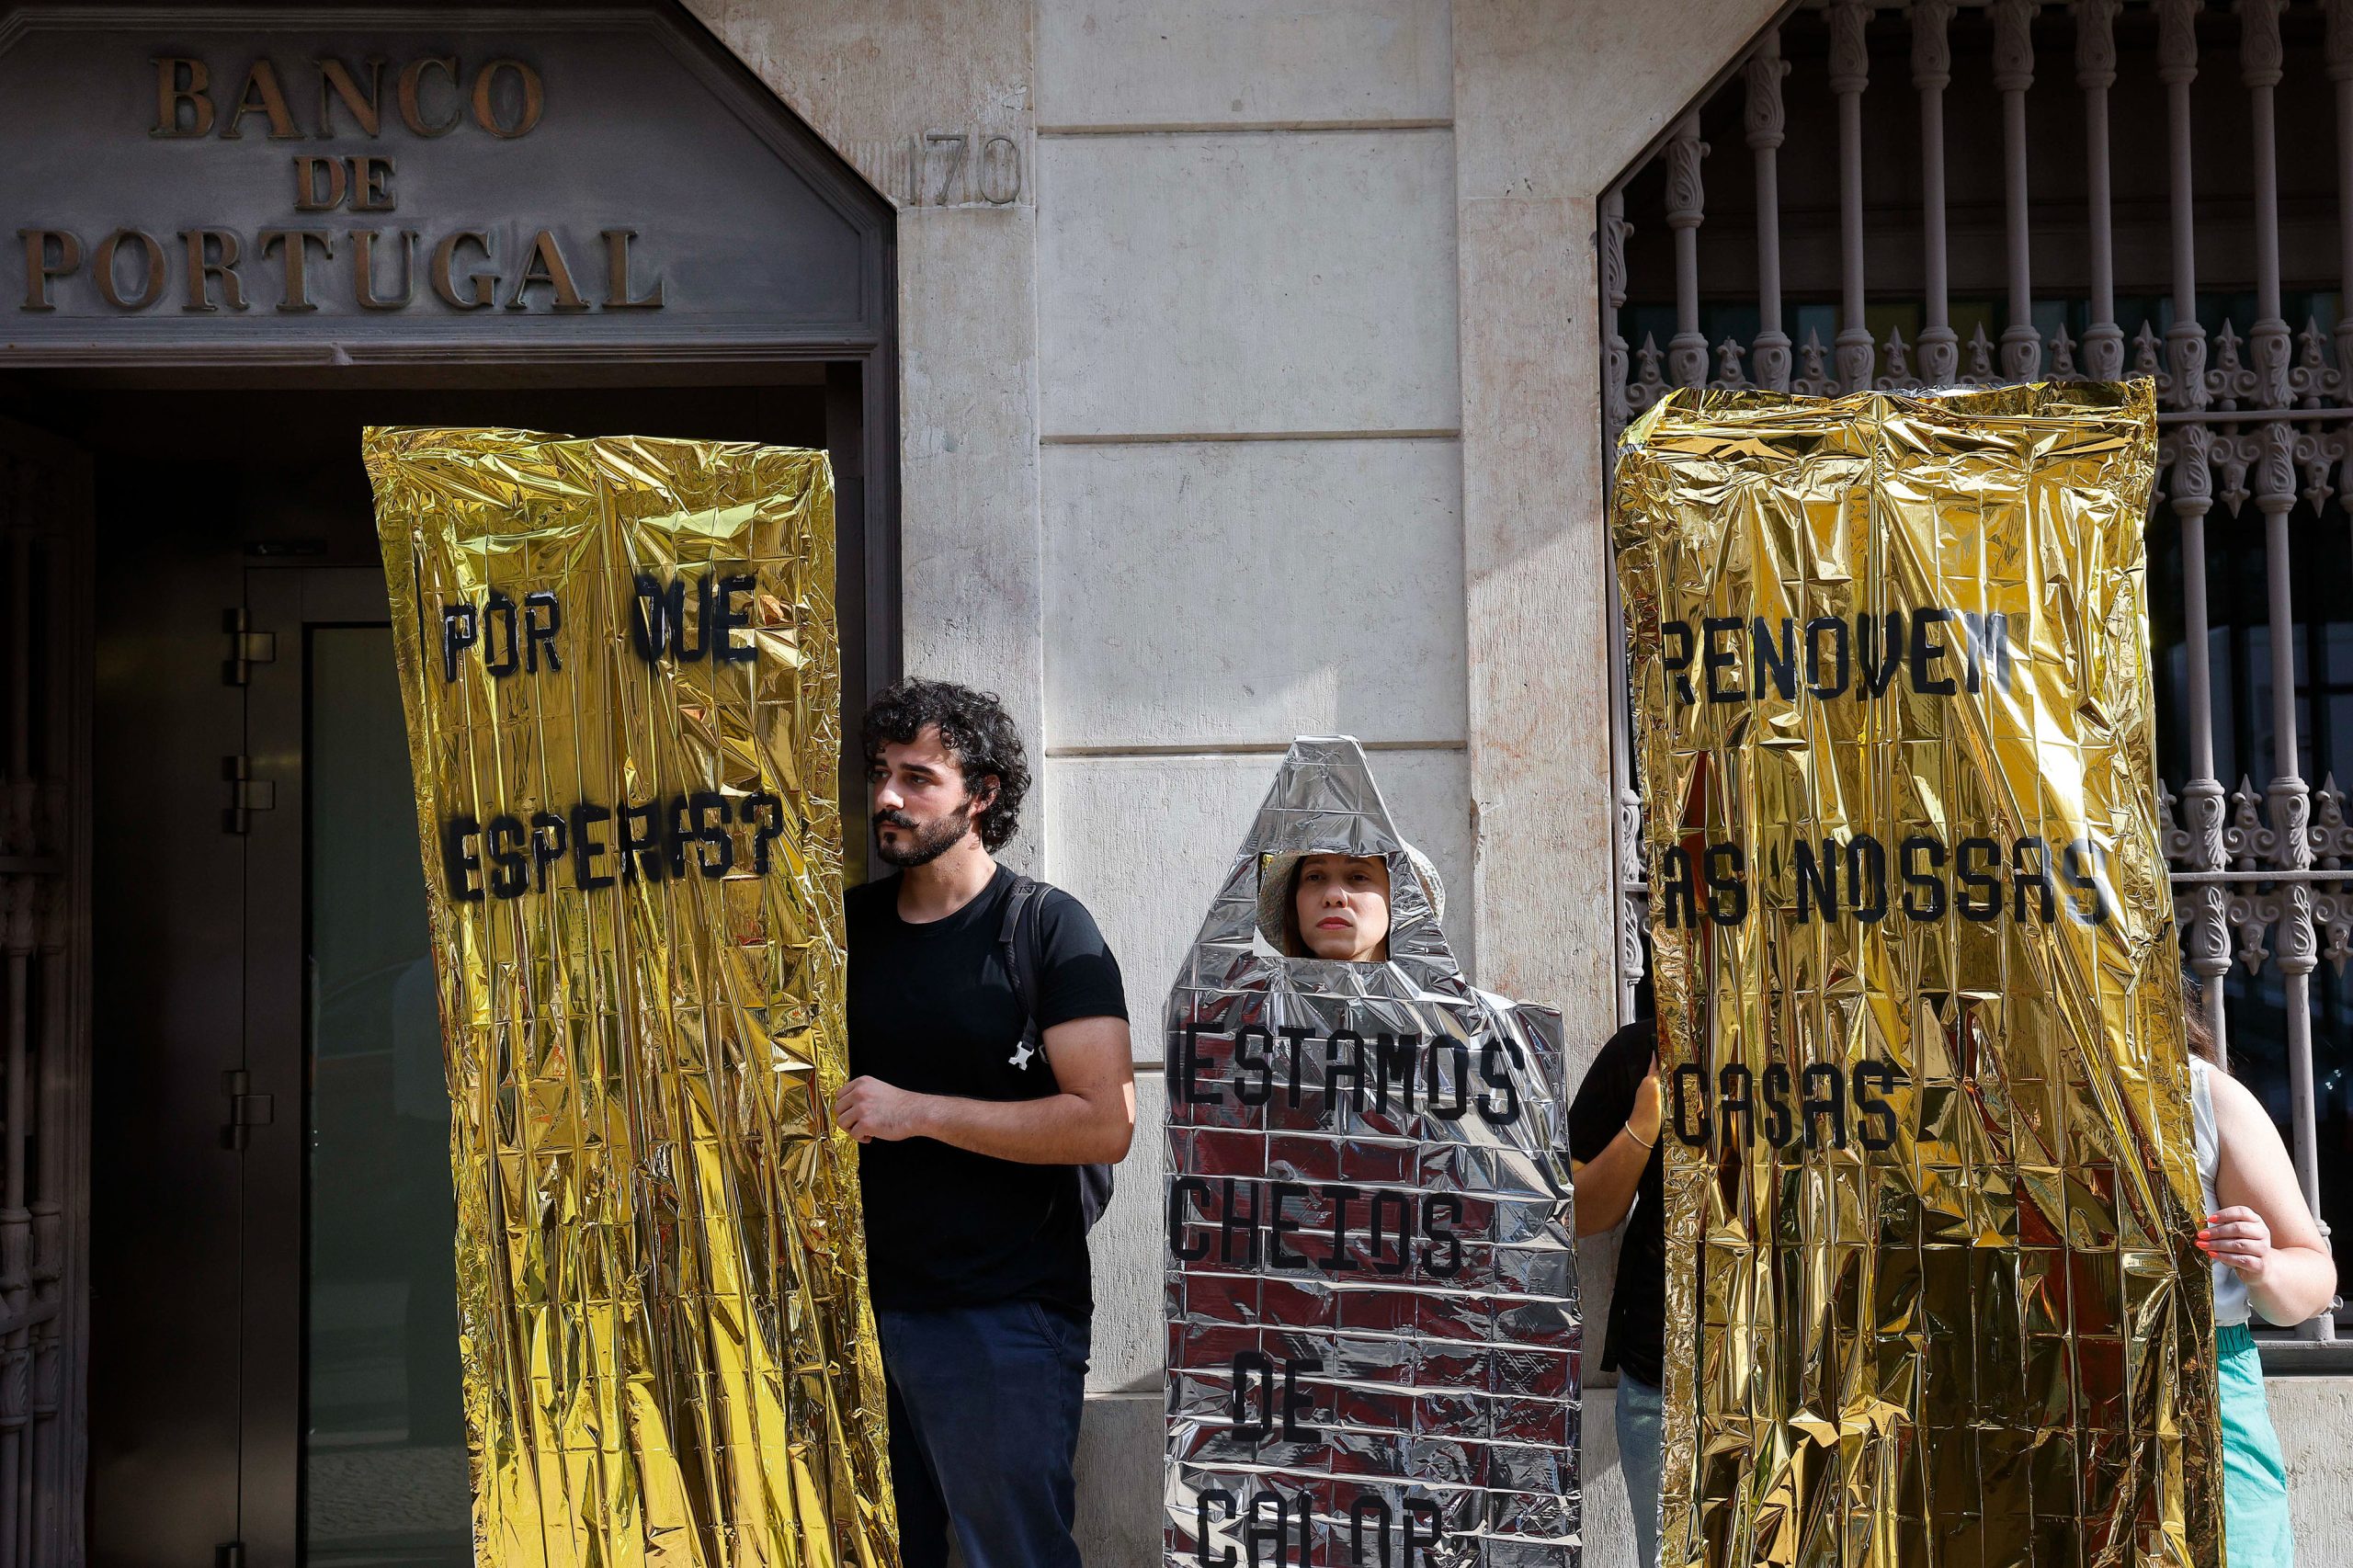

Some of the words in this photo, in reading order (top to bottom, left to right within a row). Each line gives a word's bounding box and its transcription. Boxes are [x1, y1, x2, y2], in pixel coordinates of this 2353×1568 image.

[149, 56, 544, 140] BANCO
[293, 154, 397, 211] DE
[909, 134, 1021, 205] 170
[18, 226, 666, 311] PORTUGAL
[444, 589, 562, 682] POR
[1662, 608, 2010, 704] RENOVEM
[447, 791, 783, 901] ESPERAS?
[1665, 840, 1747, 928] AS
[1796, 834, 2111, 926] NOSSAS
[1186, 1022, 1526, 1125] ESTAMOS
[1673, 1061, 1896, 1150] CASAS
[1169, 1176, 1463, 1278] CHEIOS
[1232, 1350, 1324, 1443] DE
